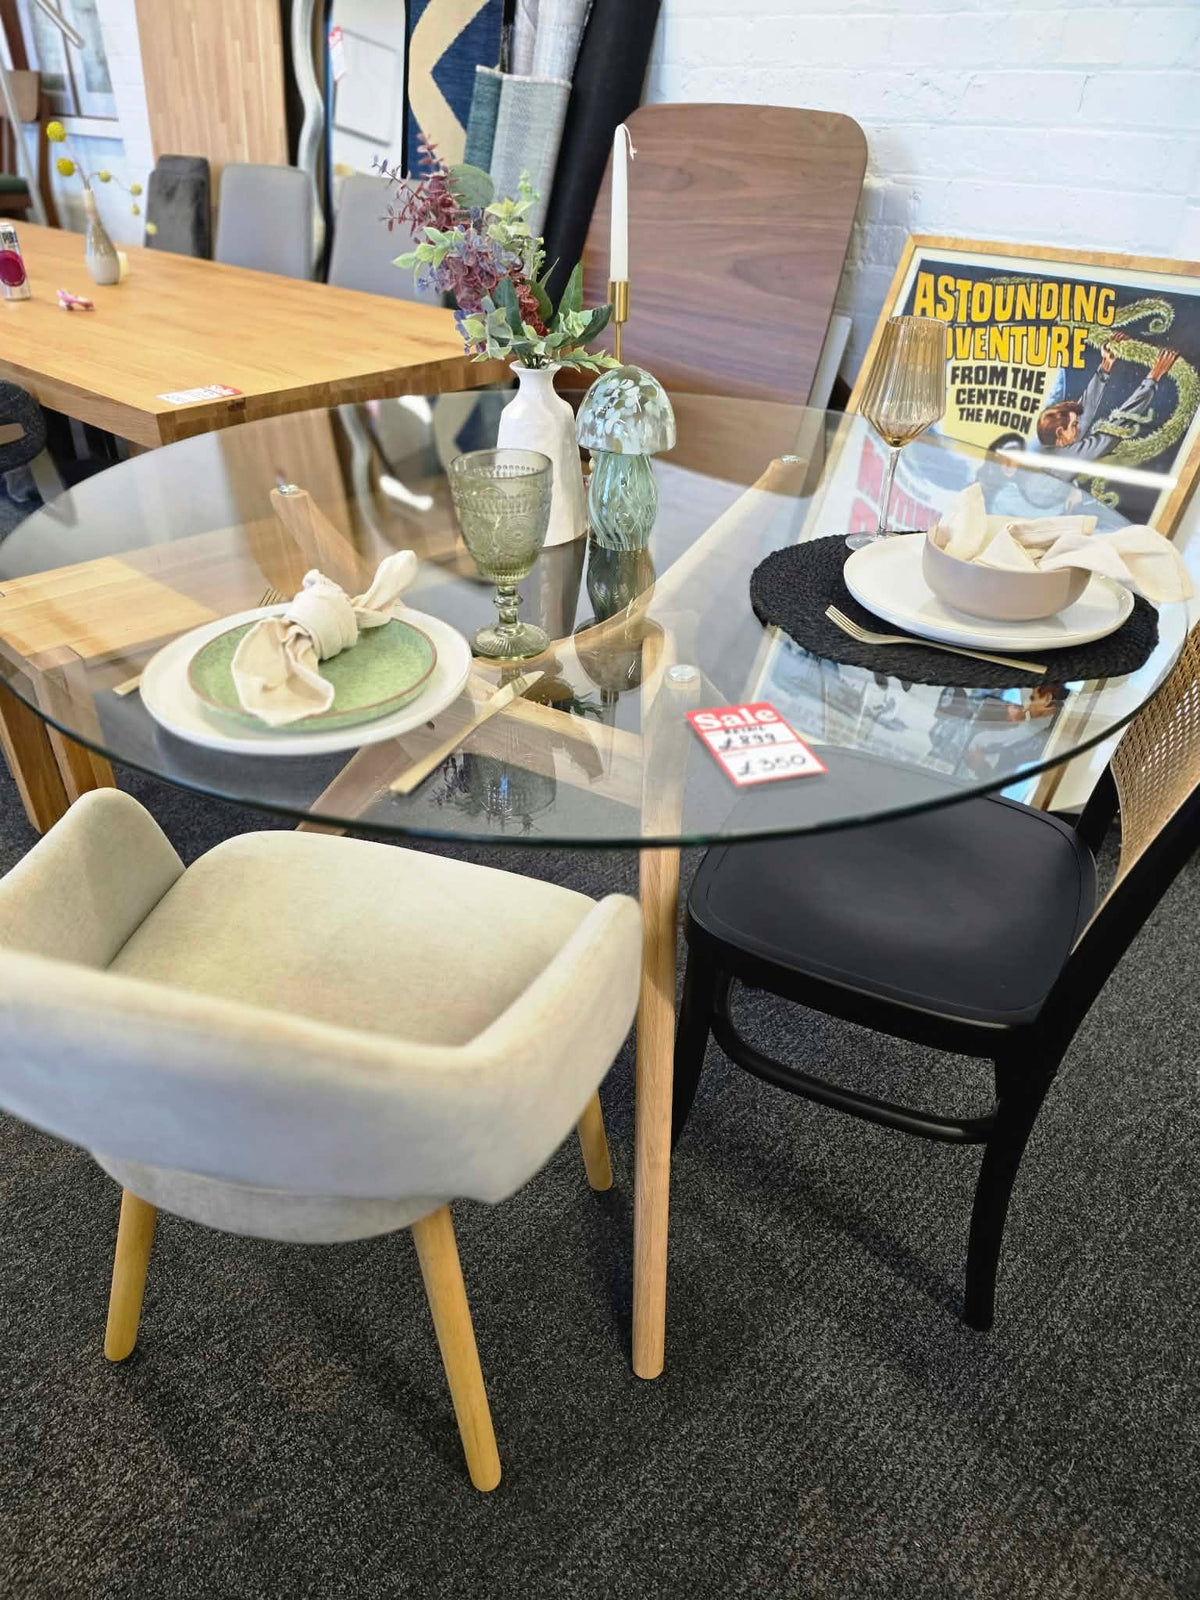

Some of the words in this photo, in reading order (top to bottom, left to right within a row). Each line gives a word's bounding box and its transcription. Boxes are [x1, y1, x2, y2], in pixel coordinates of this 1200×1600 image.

[912, 270, 1116, 326] ASTOUNDING
[946, 326, 1088, 369] VENTURE
[951, 365, 1008, 386] FROM
[1011, 367, 1046, 394] THE
[956, 388, 1018, 409] CENTER
[1020, 396, 1040, 413] OF
[959, 407, 983, 422] THE
[985, 409, 1032, 434] MOON
[693, 708, 778, 731] Sale
[738, 754, 806, 776] £350
